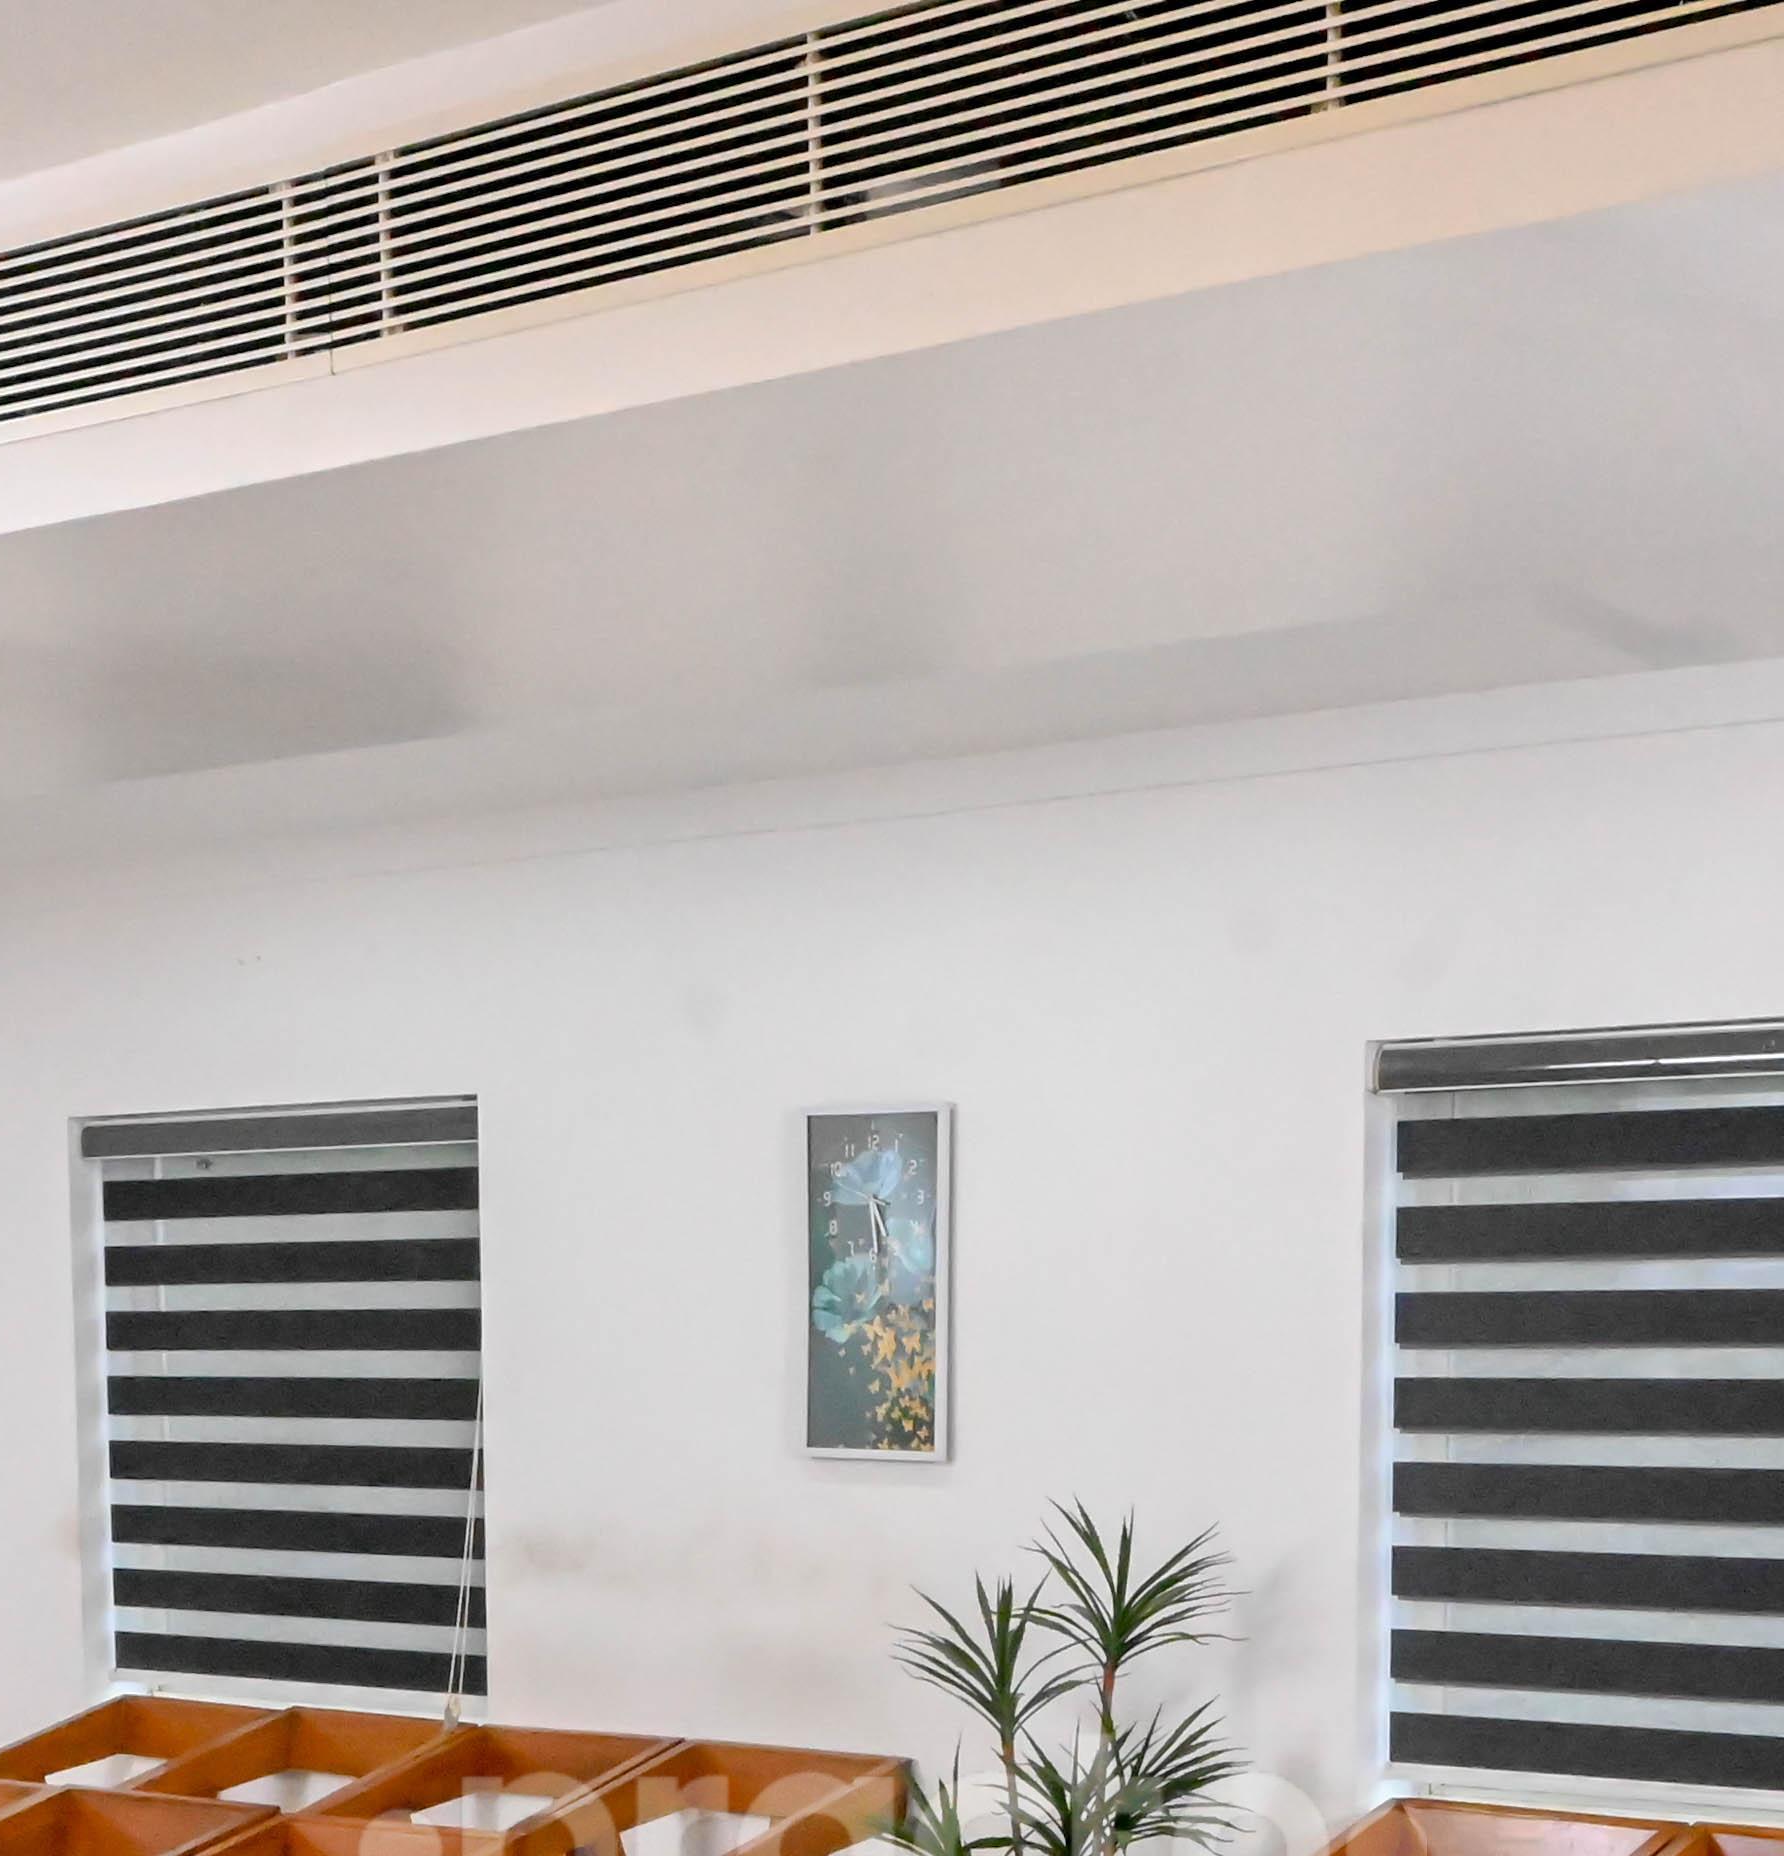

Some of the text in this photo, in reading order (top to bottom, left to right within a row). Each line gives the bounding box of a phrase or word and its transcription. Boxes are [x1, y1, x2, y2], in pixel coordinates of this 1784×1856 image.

[868, 1134, 880, 1150] 12
[845, 1143, 855, 1158] 11
[830, 1161, 842, 1177] 10
[908, 1159, 917, 1175] 2
[823, 1191, 831, 1207] 9
[917, 1189, 925, 1204] 3
[829, 1220, 837, 1235] 8
[847, 1240, 855, 1256] 7
